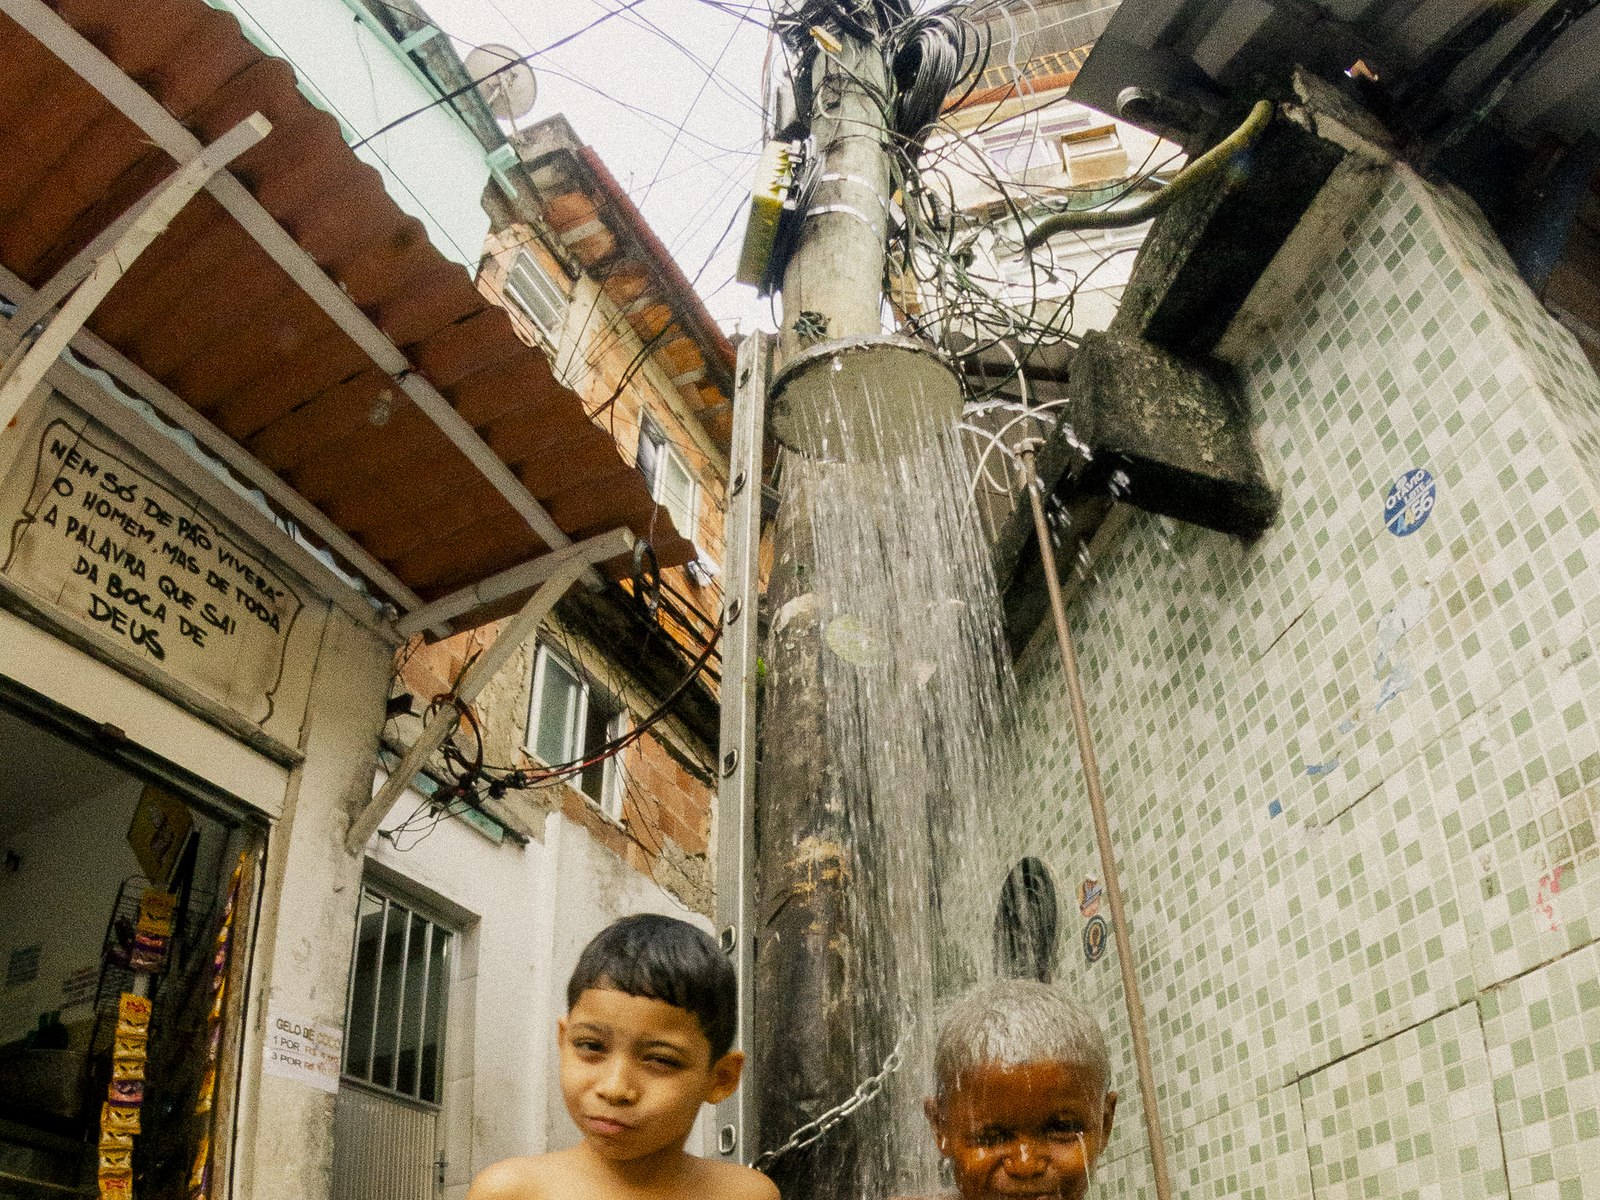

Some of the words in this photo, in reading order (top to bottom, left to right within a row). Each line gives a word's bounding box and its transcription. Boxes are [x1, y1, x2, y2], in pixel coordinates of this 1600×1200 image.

[50, 439, 99, 478] NEM
[99, 472, 138, 503] SÓ
[143, 497, 174, 528] DE
[178, 516, 212, 551] PÃO
[218, 546, 284, 602] VIVERÁ
[52, 477, 74, 497] O
[162, 541, 200, 575] MAS
[205, 569, 231, 595] DE
[235, 586, 280, 634] TODA
[43, 504, 58, 530] A
[65, 515, 146, 582] PALAVRA
[158, 574, 198, 611] QUE
[199, 602, 237, 635] SAI
[72, 554, 99, 585] DA
[106, 572, 167, 624] BOCA
[178, 614, 209, 648] DE
[87, 592, 166, 662] DEUS
[271, 1051, 278, 1061] 3
[280, 1054, 302, 1069] POR
[273, 1036, 279, 1045] 1
[280, 1037, 301, 1052] POR
[276, 1018, 301, 1036] GELO
[303, 1027, 316, 1041] DE
